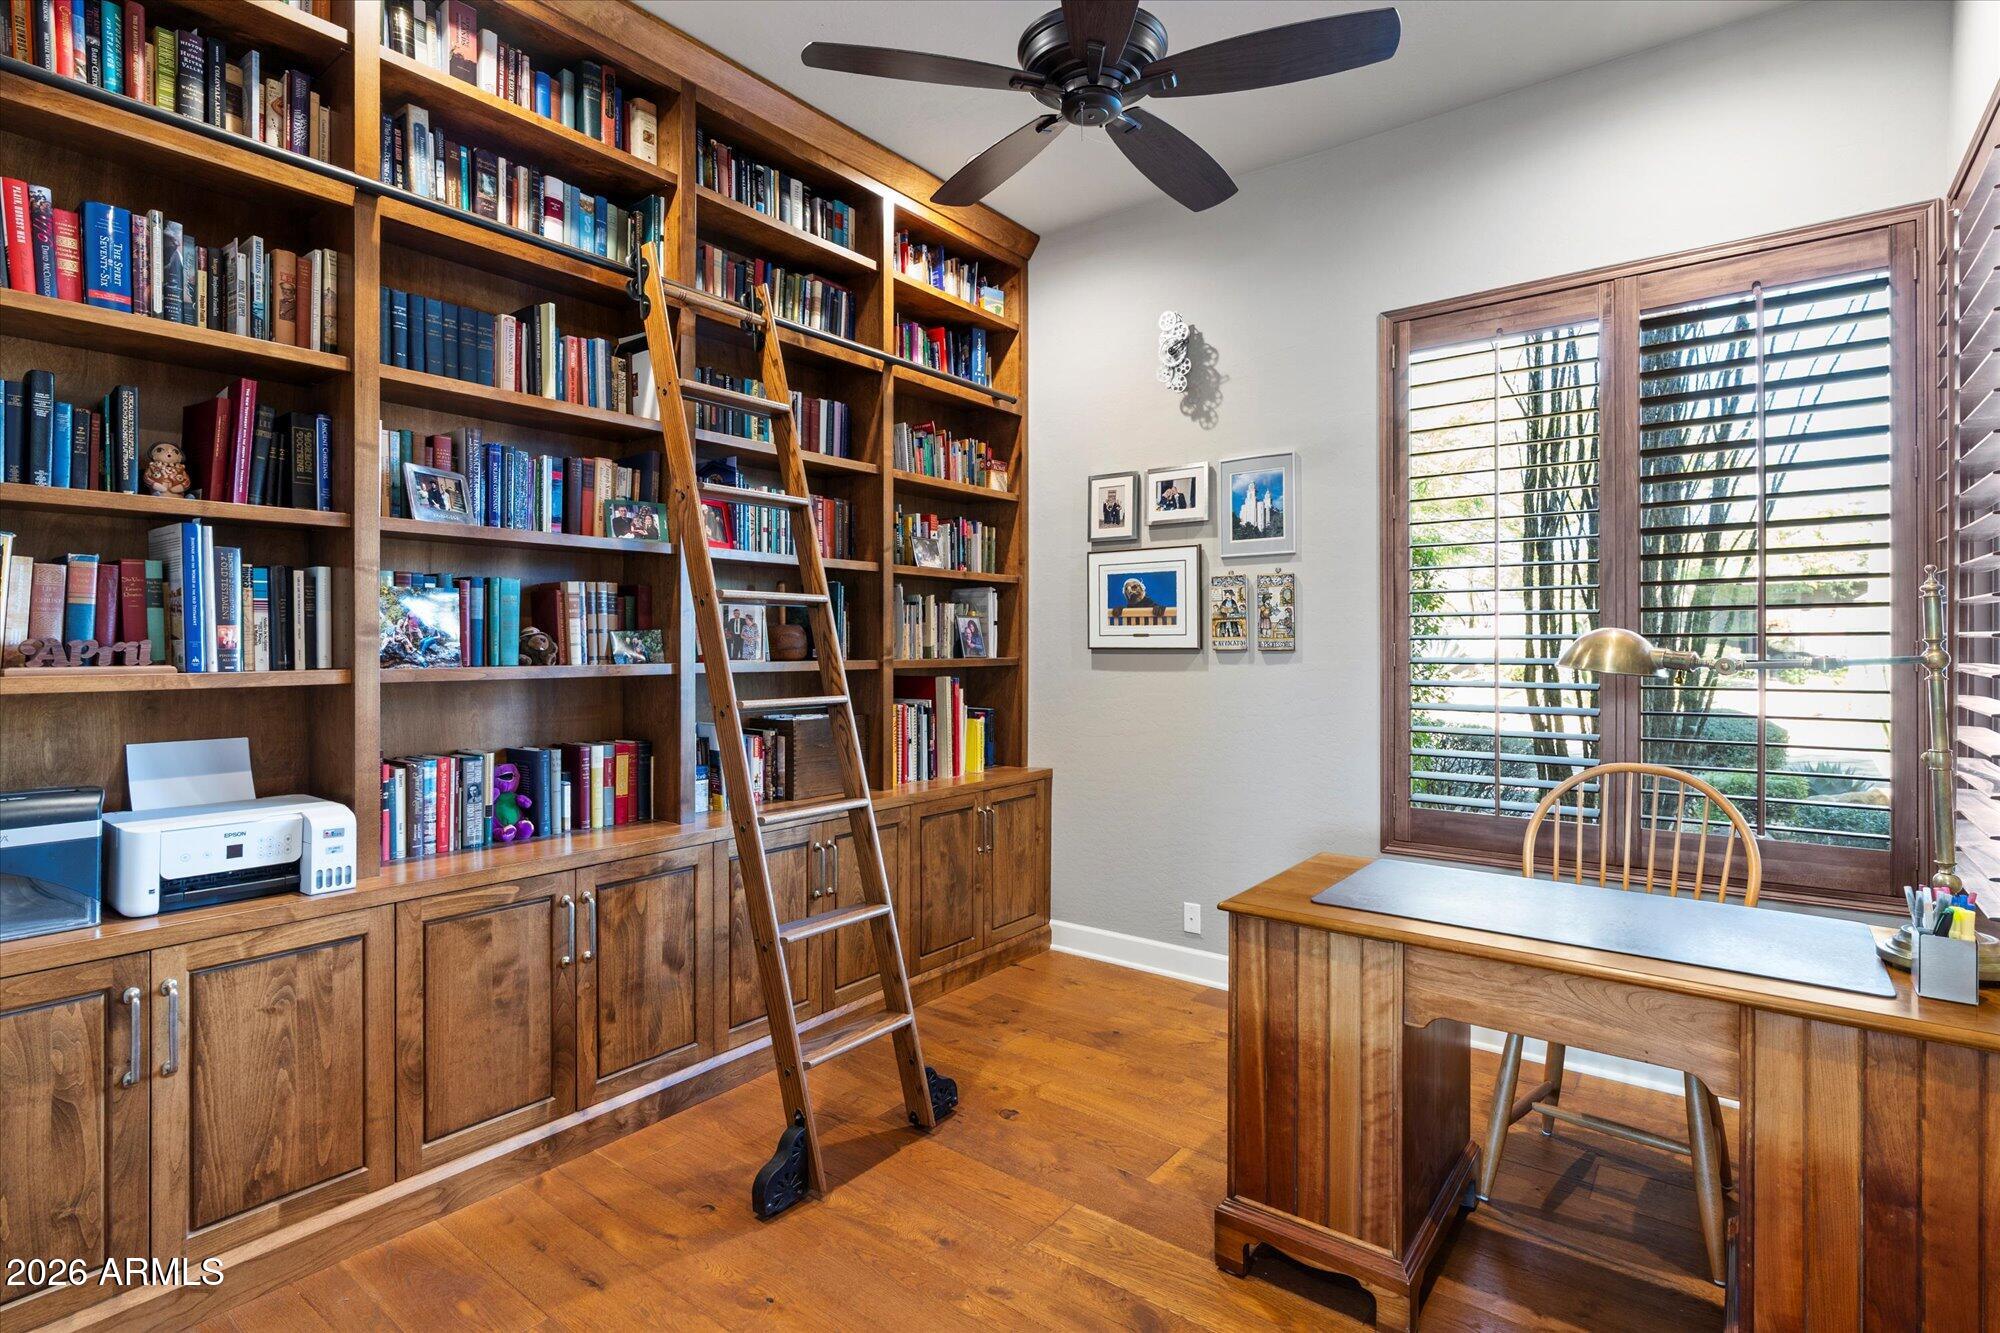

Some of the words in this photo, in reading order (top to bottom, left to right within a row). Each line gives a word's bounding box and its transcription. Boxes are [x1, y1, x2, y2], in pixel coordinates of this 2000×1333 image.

[15, 15, 27, 52] COLUMBUS
[106, 30, 114, 68] STRANGE
[180, 41, 204, 53] HISTORY
[180, 50, 204, 63] HUDSON
[181, 62, 204, 74] VALLEY
[183, 57, 203, 68] RIVER
[91, 65, 99, 87] CLIFFO
[14, 206, 25, 229] HONEST
[16, 229, 26, 244] MEN
[41, 244, 50, 262] DAVID
[100, 235, 110, 287] SEVENTY-SIX
[113, 243, 123, 259] THE
[42, 262, 52, 297] McCULLOUG
[113, 260, 123, 286] SPIRIT
[220, 561, 229, 578] OLD
[221, 579, 230, 620] TESTAMENT
[18, 637, 152, 667] April
[223, 831, 247, 839] EPSON
